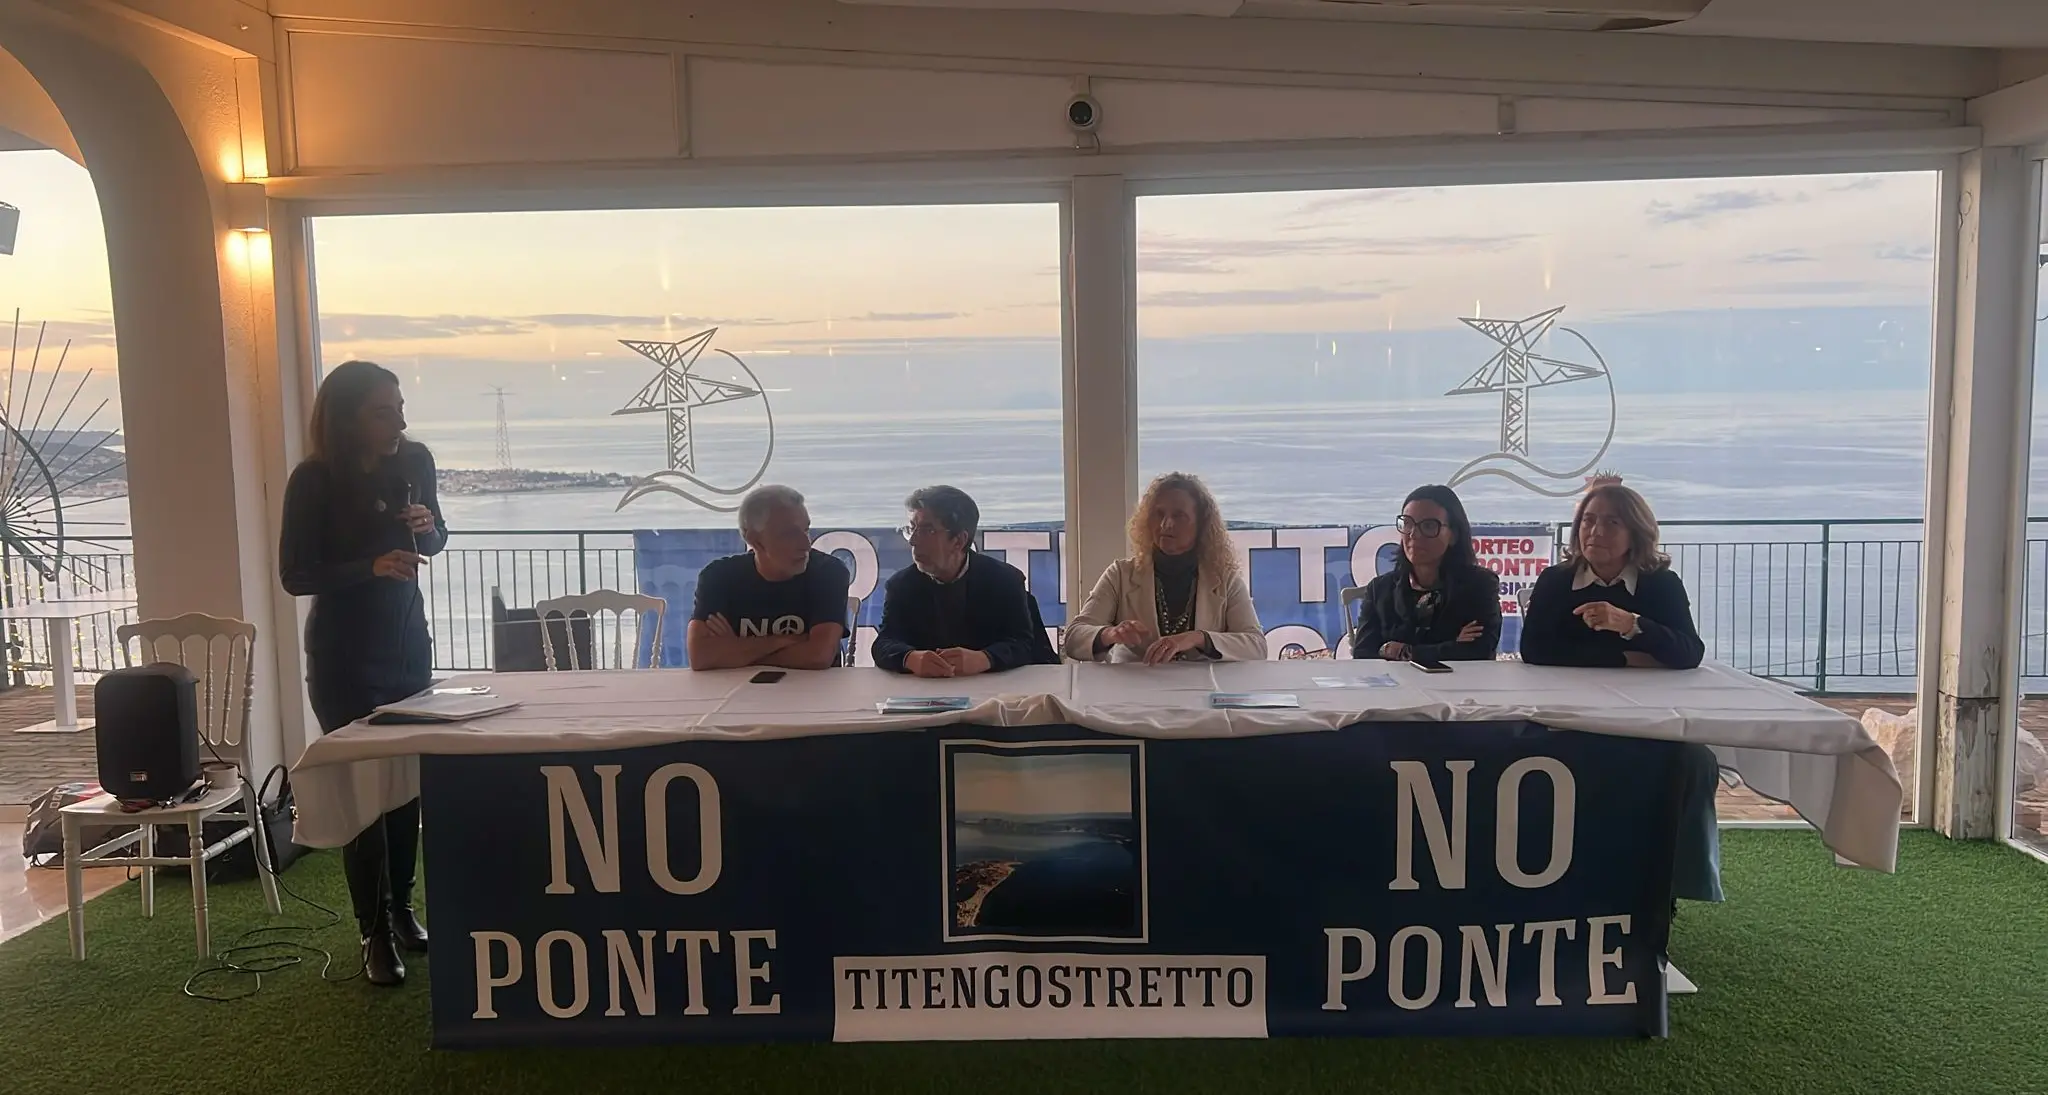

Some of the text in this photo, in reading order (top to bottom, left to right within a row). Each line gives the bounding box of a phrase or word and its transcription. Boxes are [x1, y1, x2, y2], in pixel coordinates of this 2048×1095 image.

[1471, 538, 1534, 554] ORTEO
[1477, 558, 1549, 576] ONTE
[540, 763, 723, 895] NO
[1389, 756, 1576, 890] NO
[470, 929, 781, 1019] PONTE
[844, 963, 1254, 1011] TITENGOSTRETTO
[1322, 914, 1638, 1012] PONTE
